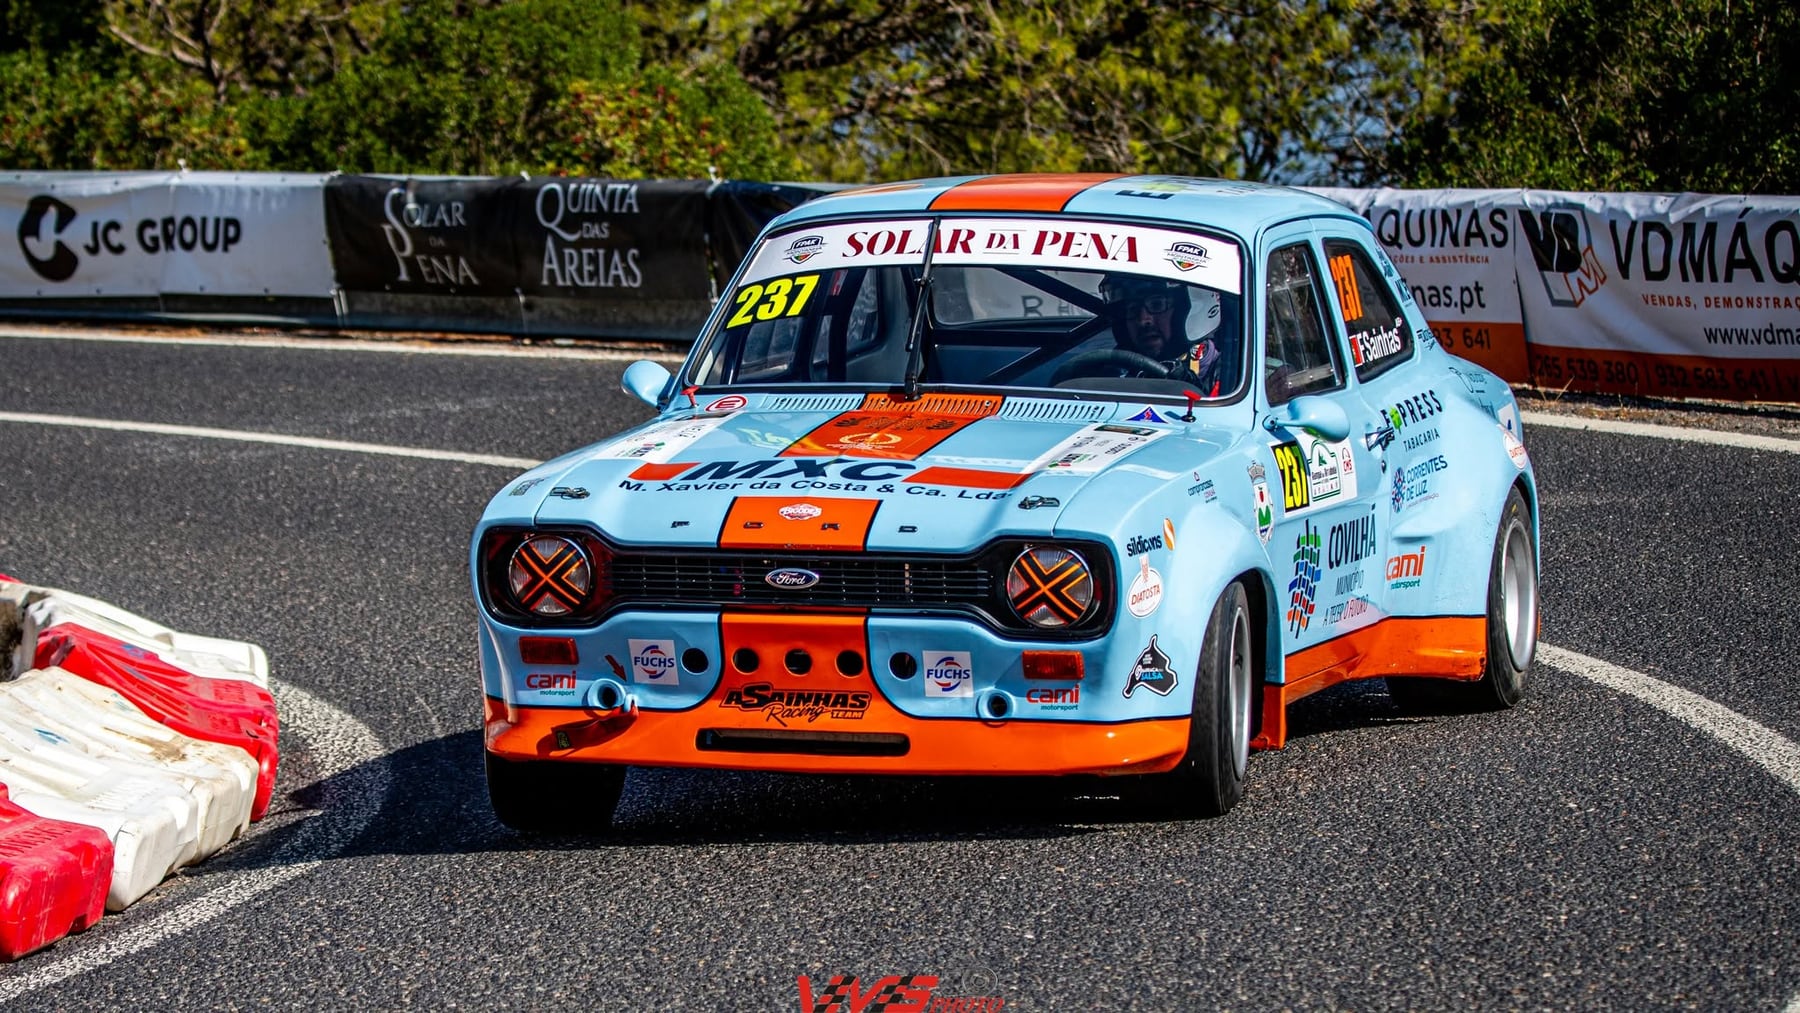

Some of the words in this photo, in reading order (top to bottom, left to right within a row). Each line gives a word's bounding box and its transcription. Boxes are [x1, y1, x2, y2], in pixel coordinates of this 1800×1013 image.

[384, 188, 467, 256] SOLAR
[536, 182, 640, 241] QUINTA
[83, 220, 125, 256] JC
[136, 215, 241, 254] GROUP
[583, 223, 610, 239] DAS
[1362, 207, 1509, 249] QUINAS
[382, 223, 480, 285] PENA
[842, 229, 974, 258] SOLAR
[986, 234, 1020, 250] DA
[1031, 230, 1139, 263] PENA
[1177, 245, 1200, 255] FPAK
[542, 235, 643, 288] AREIAS
[1429, 253, 1489, 264] ASSISTÊNCIA
[726, 274, 820, 329] 237
[1402, 280, 1486, 314] nas.pt
[1642, 294, 1697, 310] VENDAS,
[1462, 327, 1491, 350] 641
[1603, 360, 1638, 385] 380
[1403, 428, 1440, 452] TABACARIA
[681, 458, 916, 481] MXC
[1274, 446, 1308, 508] 237
[1406, 455, 1448, 484] CORRENTES
[618, 480, 647, 492] M.
[656, 480, 742, 492] Xavier
[749, 480, 779, 490] da
[790, 480, 868, 492] Costa
[877, 484, 894, 493] &
[906, 485, 946, 497] Ca.
[1407, 485, 1415, 501] DE
[1416, 479, 1428, 497] LUZ
[1386, 546, 1426, 581] cami
[1131, 584, 1160, 605] DIATOSTA
[634, 656, 675, 671] FUCHS
[926, 668, 971, 681] FUCHS
[526, 670, 577, 689] cami
[540, 689, 576, 698] motorsport
[1026, 684, 1081, 704] cami
[761, 703, 830, 727] Racing
[831, 710, 864, 719] TEAM
[1041, 703, 1079, 714] motorsport
